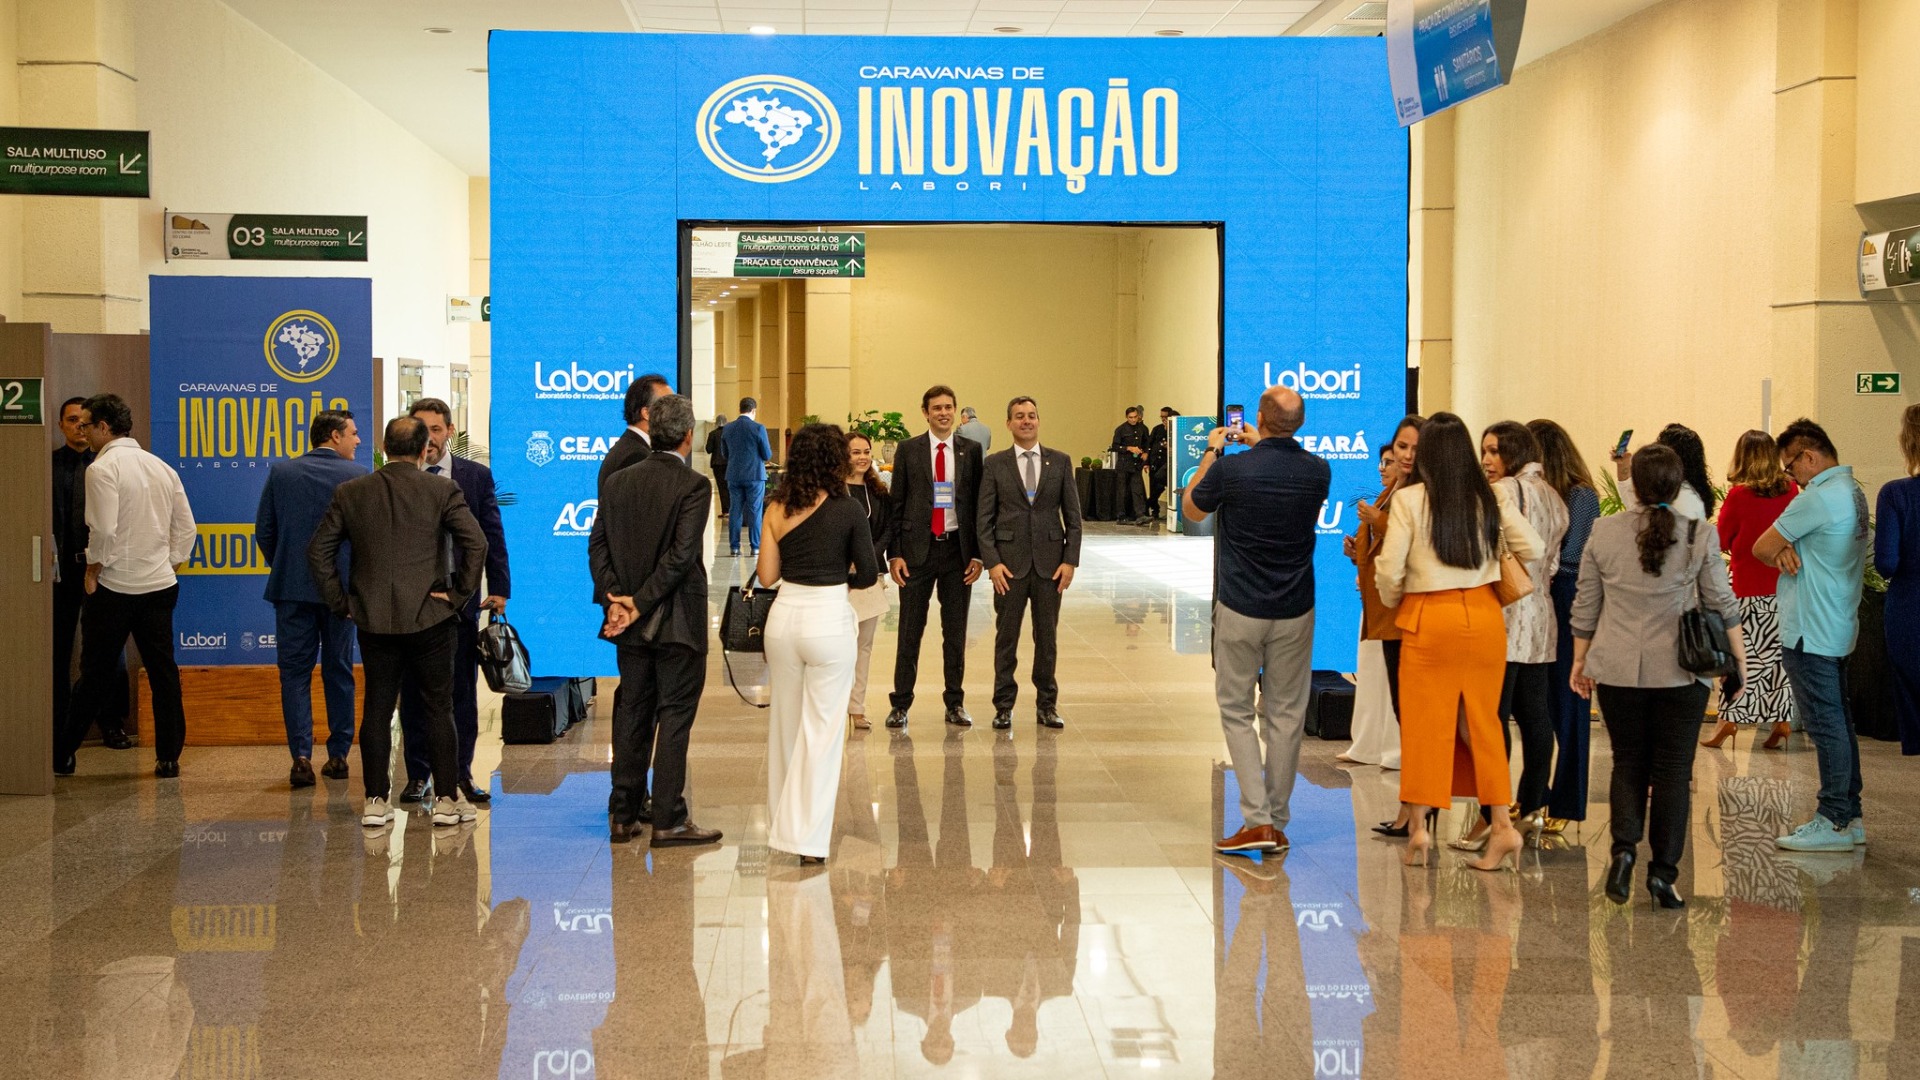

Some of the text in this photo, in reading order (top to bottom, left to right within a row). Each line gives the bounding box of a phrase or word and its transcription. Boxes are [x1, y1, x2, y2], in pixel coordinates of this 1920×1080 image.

[859, 66, 1044, 80] CARAVANAS DE
[858, 78, 1178, 194] INOVAÇÃO
[7, 146, 107, 160] SALA MULTIUSO
[9, 163, 107, 176] multipurpose room
[859, 181, 1027, 191] LABORI
[232, 227, 265, 247] 03
[296, 228, 340, 236] MULTIUSO
[768, 235, 807, 243] MULTIUSO
[274, 239, 319, 247] multipurpose
[742, 259, 769, 268] PRAÇA
[783, 257, 839, 266] CONVIVÊNCIA
[535, 361, 634, 392] Labori
[1264, 362, 1360, 391] Labori
[179, 383, 278, 393] CARAVANAS DE
[0, 381, 23, 410] 2
[189, 534, 269, 568] AUDI
[180, 632, 226, 646] Labori
